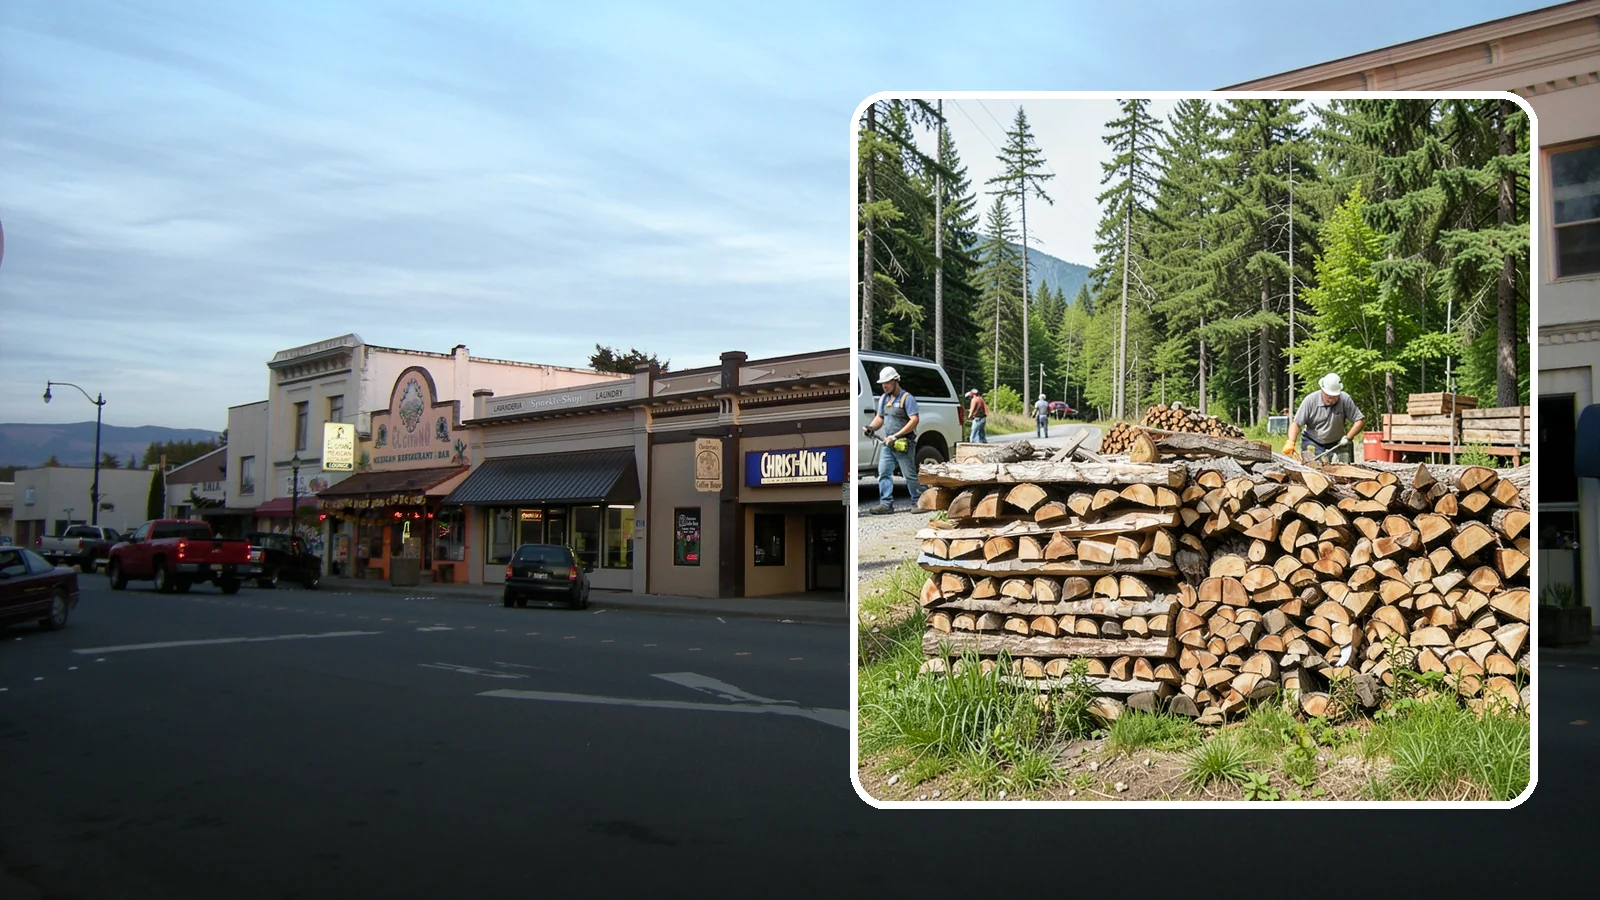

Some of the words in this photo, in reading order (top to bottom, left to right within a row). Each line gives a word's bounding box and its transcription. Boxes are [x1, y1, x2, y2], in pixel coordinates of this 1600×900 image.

[595, 389, 624, 400] LAUNDRY
[493, 402, 523, 413] LAVANDERIA
[531, 395, 560, 408] Sparkle
[560, 395, 583, 405] Shop
[373, 454, 396, 464] MEXICAN
[397, 451, 433, 462] RESTAURANT
[437, 450, 450, 459] BAR
[761, 452, 797, 478] CHRIST
[799, 450, 827, 476] KING
